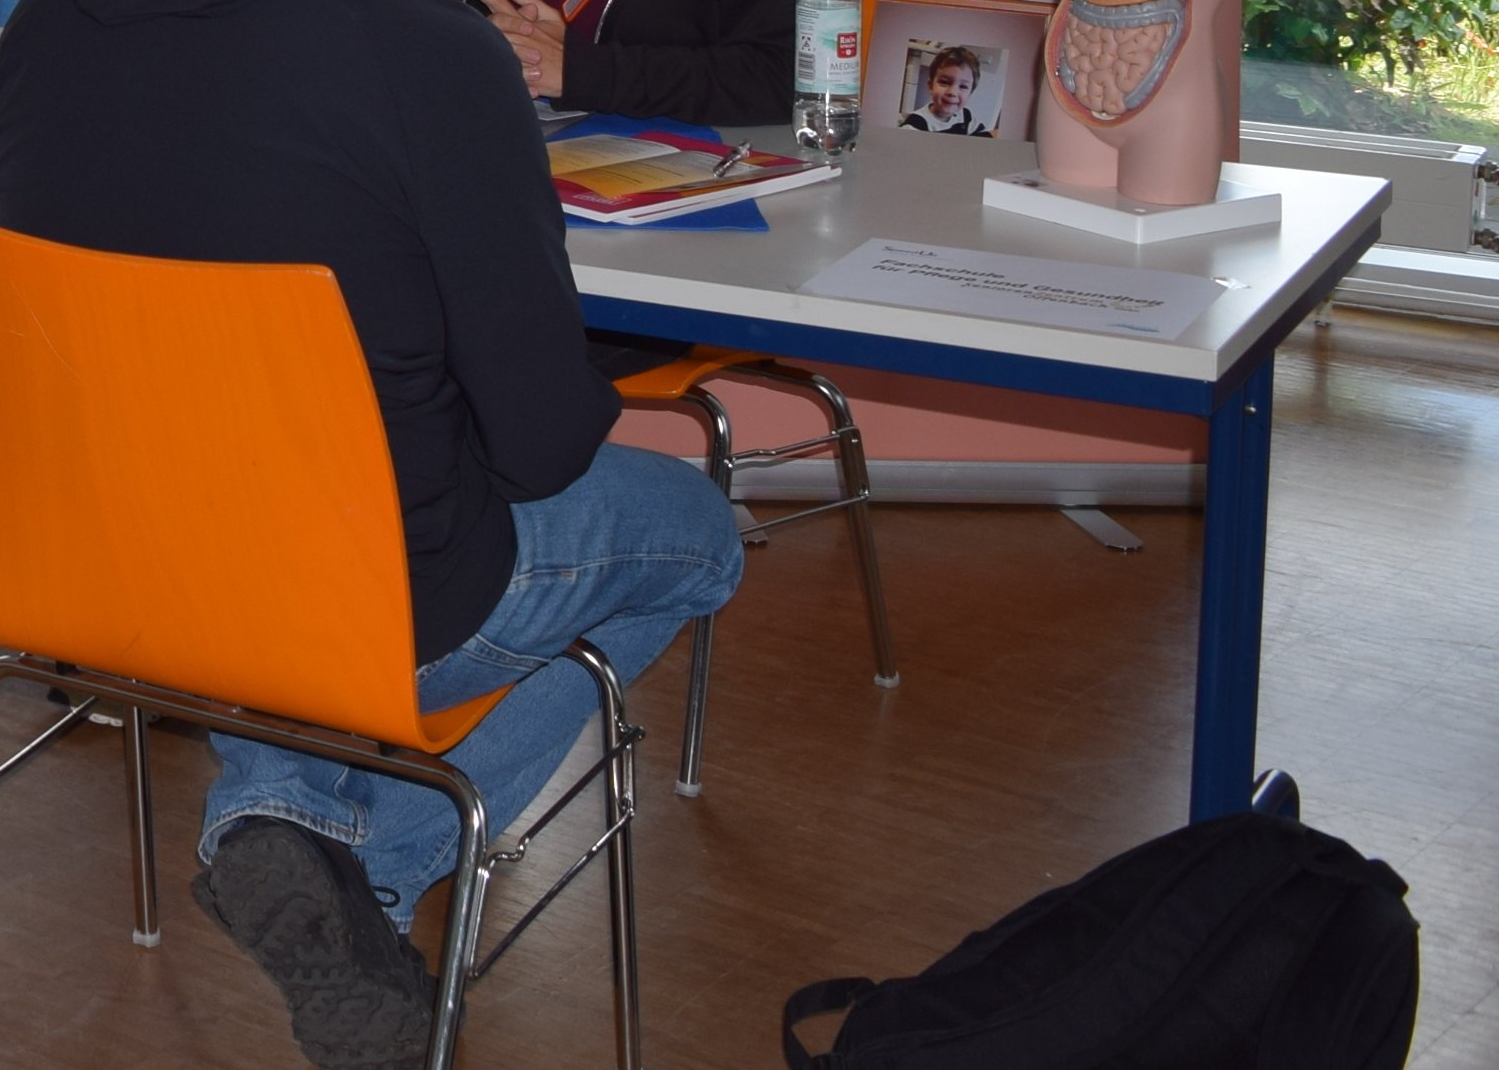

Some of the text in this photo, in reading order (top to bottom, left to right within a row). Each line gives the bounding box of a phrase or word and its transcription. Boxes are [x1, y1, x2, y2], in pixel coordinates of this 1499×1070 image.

[880, 259, 1005, 279] Fachschule
[908, 269, 977, 282] Pflege
[983, 280, 1028, 289] und
[1033, 285, 1165, 306] Gesundheit
